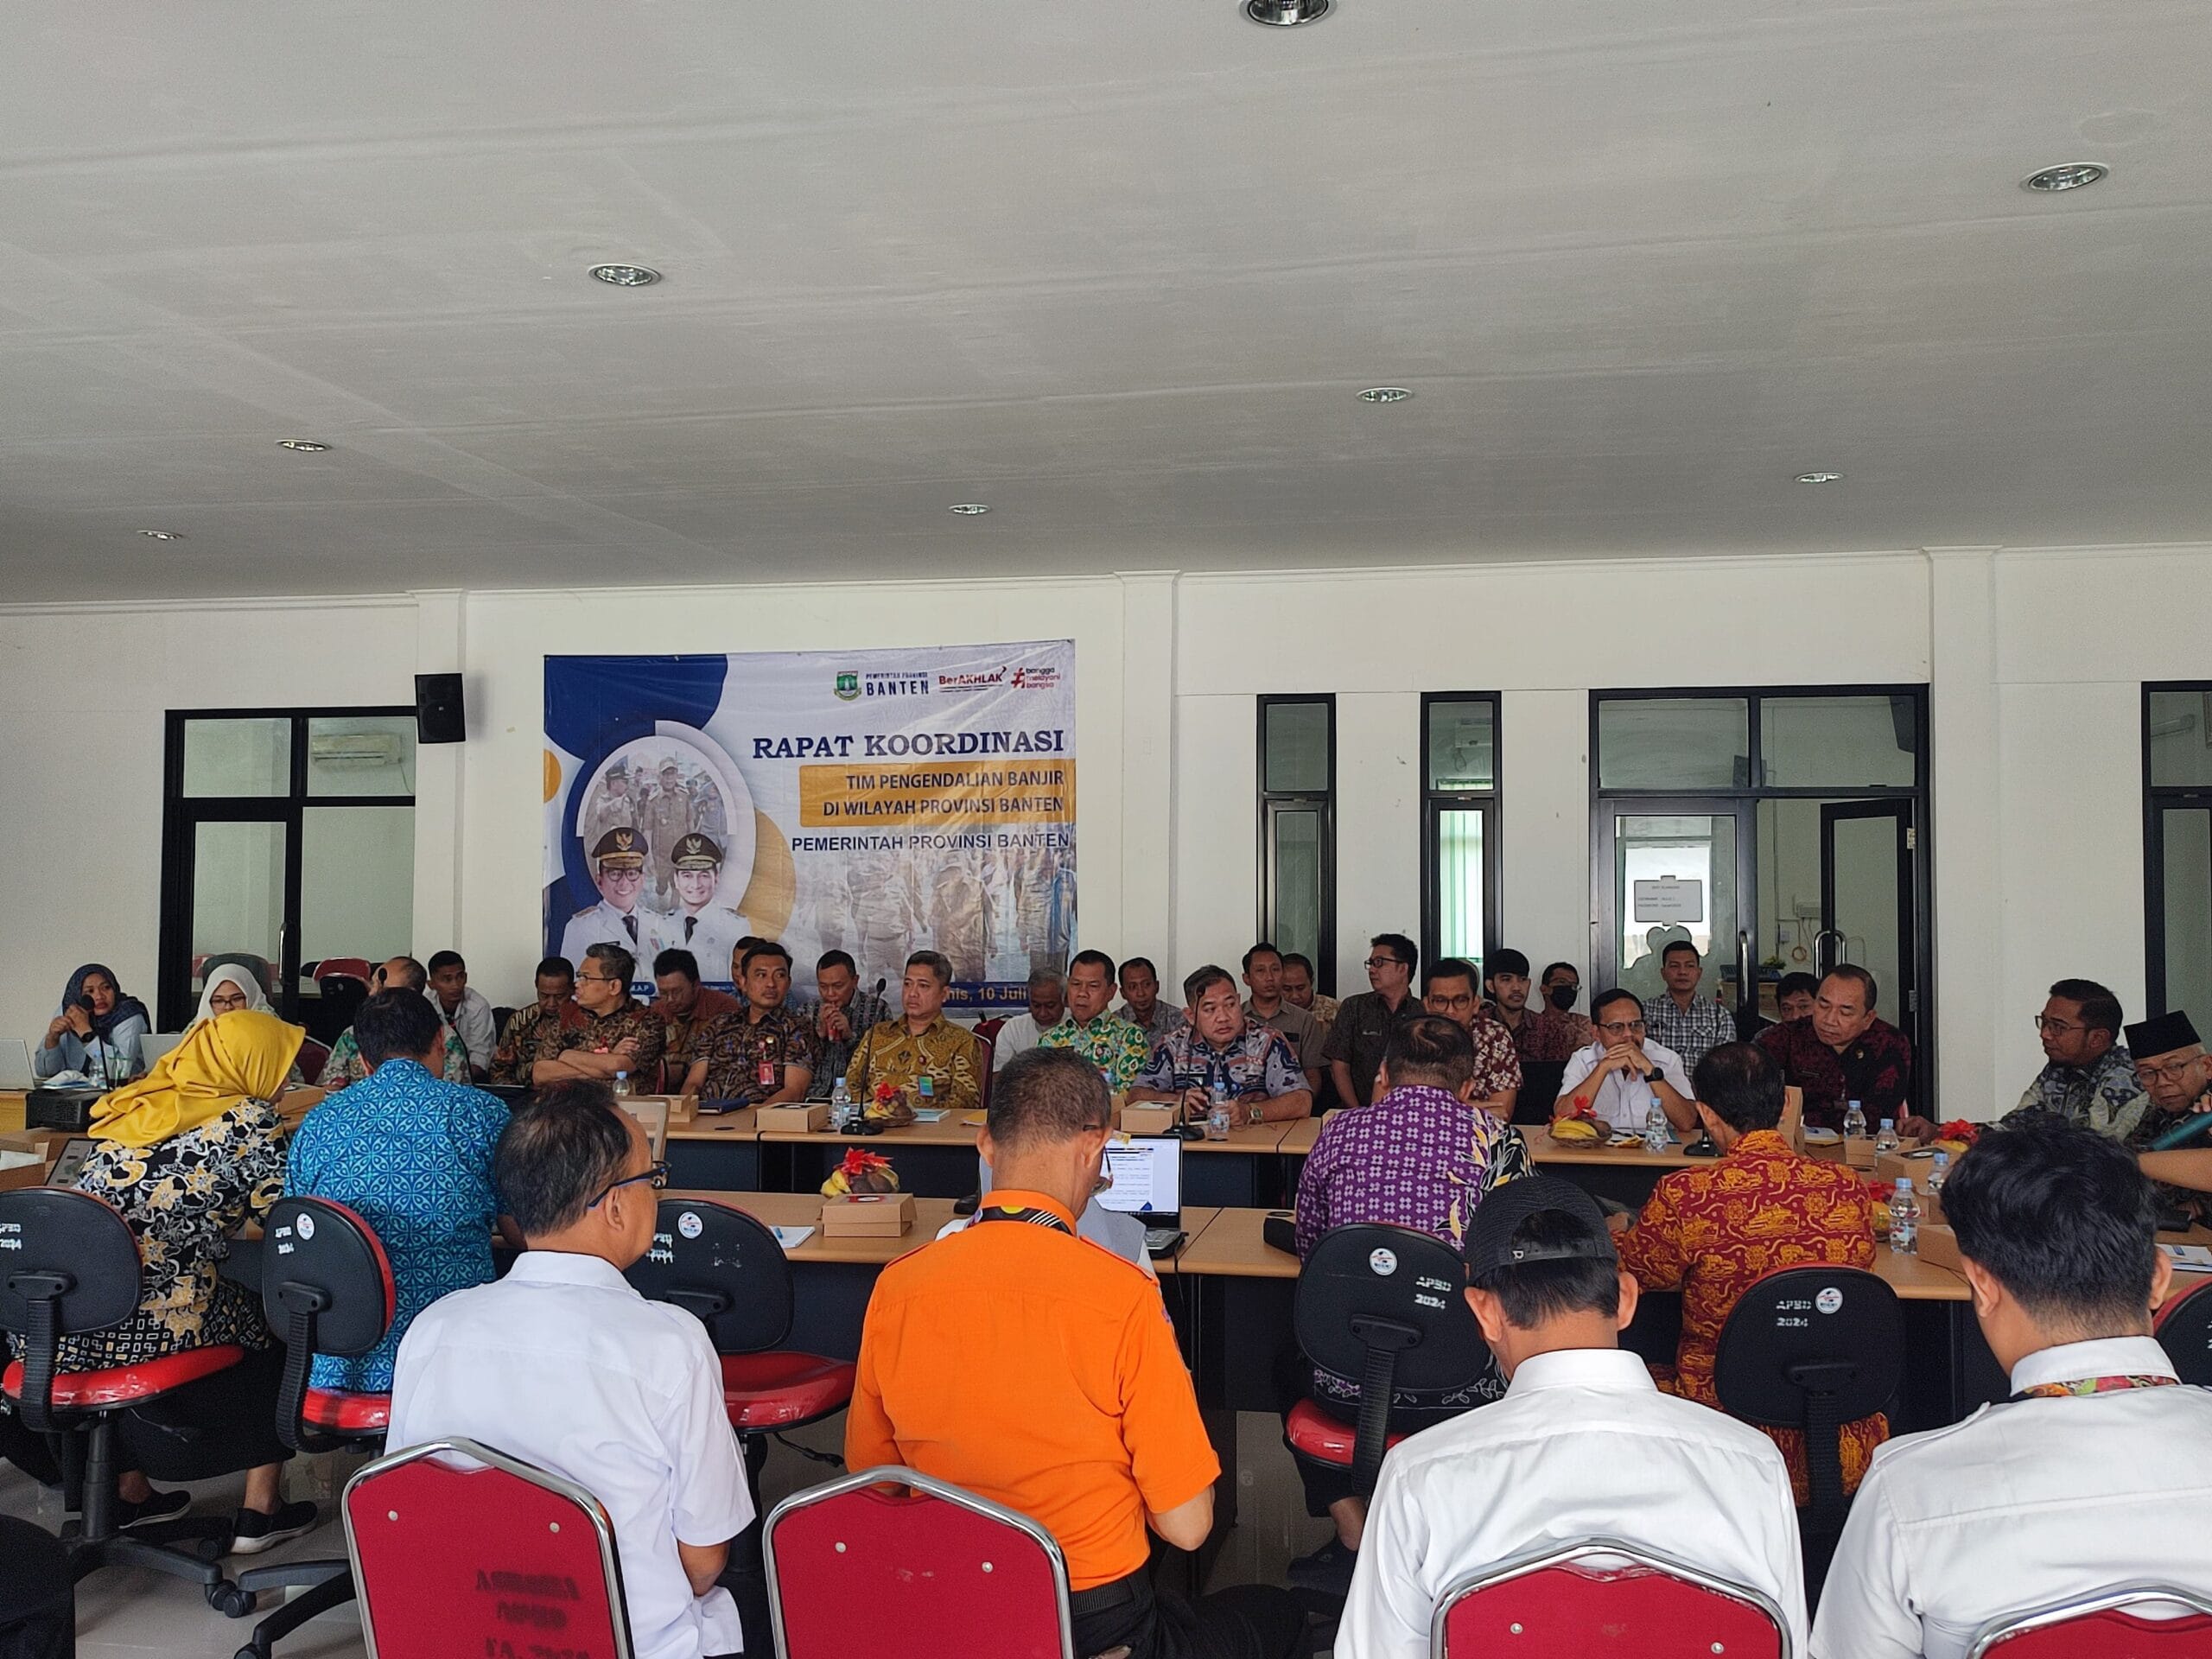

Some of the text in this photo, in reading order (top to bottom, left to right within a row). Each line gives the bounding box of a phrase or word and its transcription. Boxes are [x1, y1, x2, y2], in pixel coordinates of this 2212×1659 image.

[938, 666, 1007, 684] BerAKHLAK
[866, 680, 929, 696] BANTEN
[1026, 681, 1054, 690] bangsa
[753, 730, 1064, 759] RAPAT KOORDINASI
[846, 770, 1064, 790] TIM PENGENDALIAN BANJIR
[823, 797, 1064, 816] DI WILAYAH PROVINSI BANTEN
[791, 832, 1070, 851] PEMERINTAH PROVINSI BANTEN
[978, 988, 995, 1000] 10
[1000, 987, 1027, 1000] Juli
[1414, 1294, 1446, 1309] 2024
[1776, 1317, 1808, 1327] 2024
